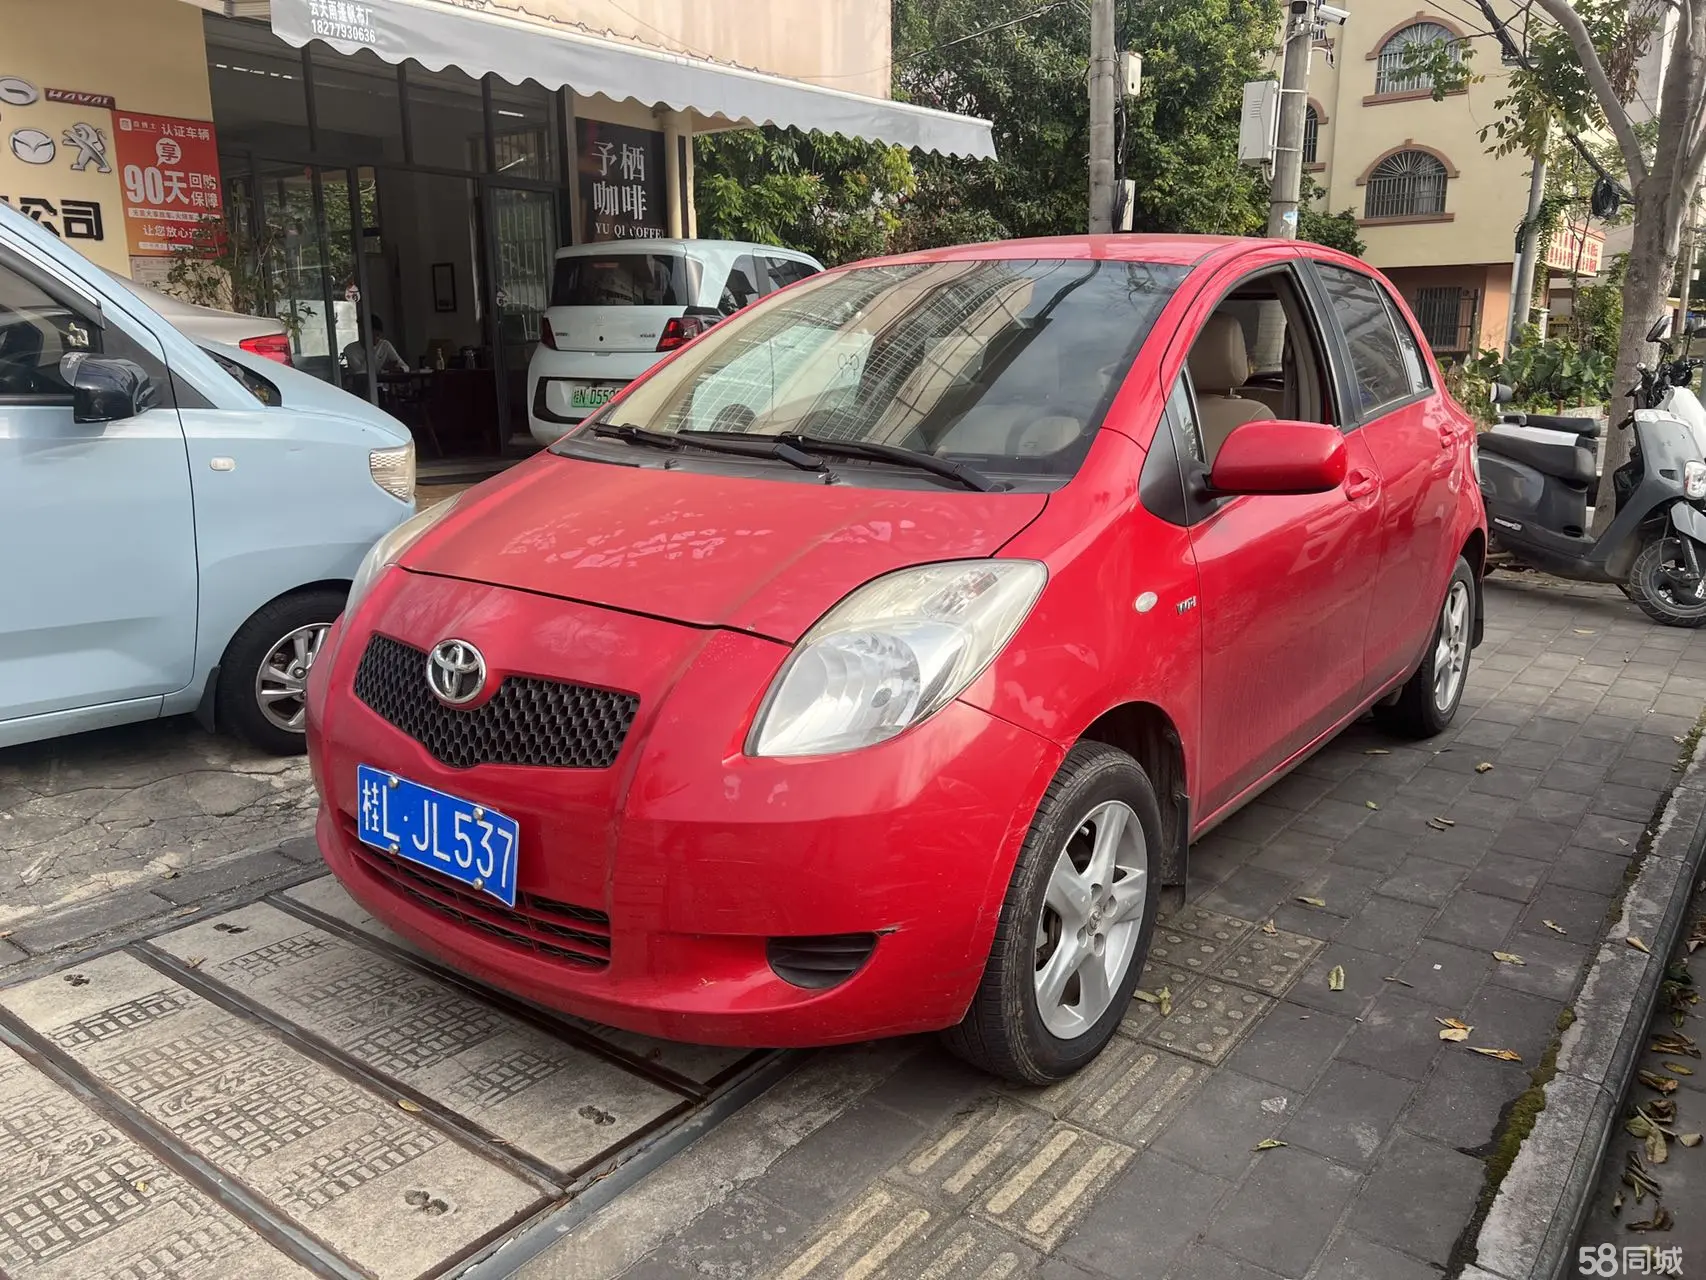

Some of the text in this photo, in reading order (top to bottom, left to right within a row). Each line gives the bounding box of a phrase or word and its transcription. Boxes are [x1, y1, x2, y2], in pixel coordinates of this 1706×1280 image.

[311, 18, 376, 43] 18277930636
[160, 124, 209, 141] 认证车辆
[160, 142, 178, 161] 享
[591, 141, 645, 181] 予栖
[123, 164, 189, 205] 90天
[188, 172, 217, 190] 回购
[191, 191, 218, 208] 保障
[593, 181, 647, 220] 咖啡
[0, 196, 103, 241] 公司
[595, 222, 665, 239] YU QI COFFE
